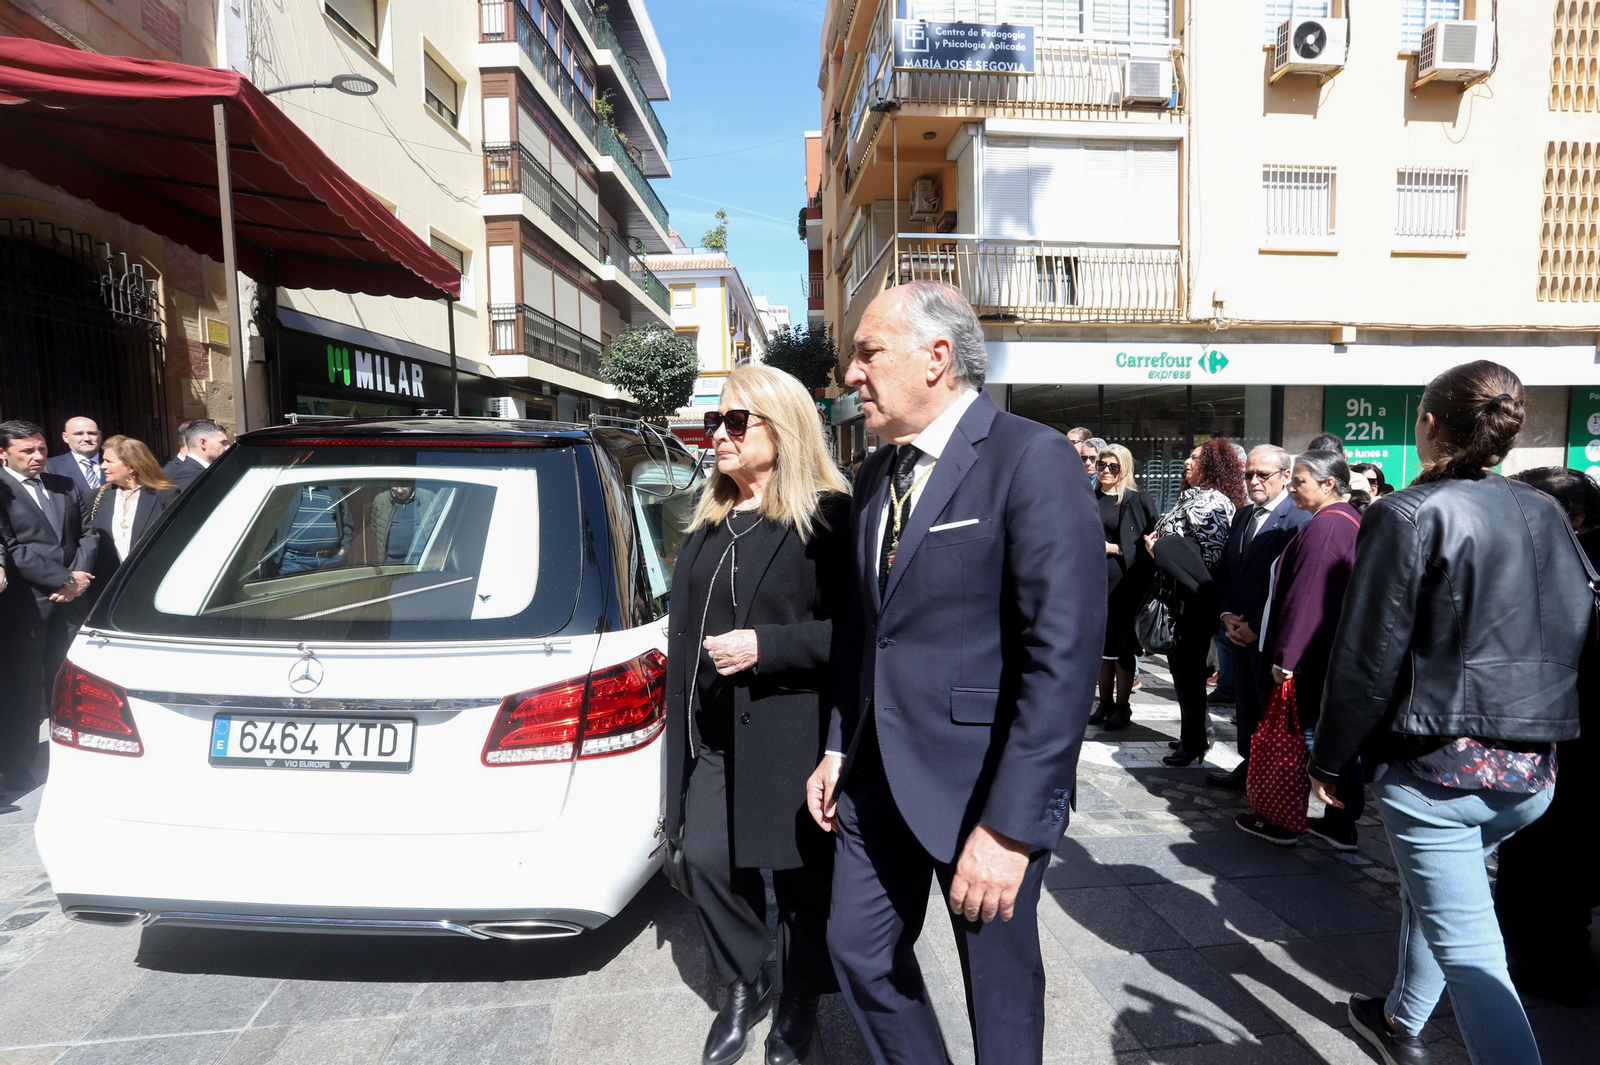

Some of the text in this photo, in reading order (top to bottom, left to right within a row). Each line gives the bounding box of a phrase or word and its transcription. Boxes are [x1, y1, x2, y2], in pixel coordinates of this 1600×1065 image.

[935, 27, 1026, 40] Centro de Pedagogía
[942, 40, 986, 51] Psicología
[988, 41, 1026, 52] Aplicada
[903, 56, 1026, 72] MARÍA JOSÉ SEGOVIA
[1116, 351, 1193, 368] Carrefour
[354, 350, 425, 398] MILAR
[1148, 369, 1191, 381] express
[1589, 392, 1600, 400] Po
[1346, 398, 1386, 417] 9h a
[1345, 421, 1384, 440] 22h
[1355, 448, 1381, 458] lunes
[216, 740, 225, 750] E
[239, 720, 399, 757] 6464 KTD
[284, 760, 331, 768] VIO EUROPE
